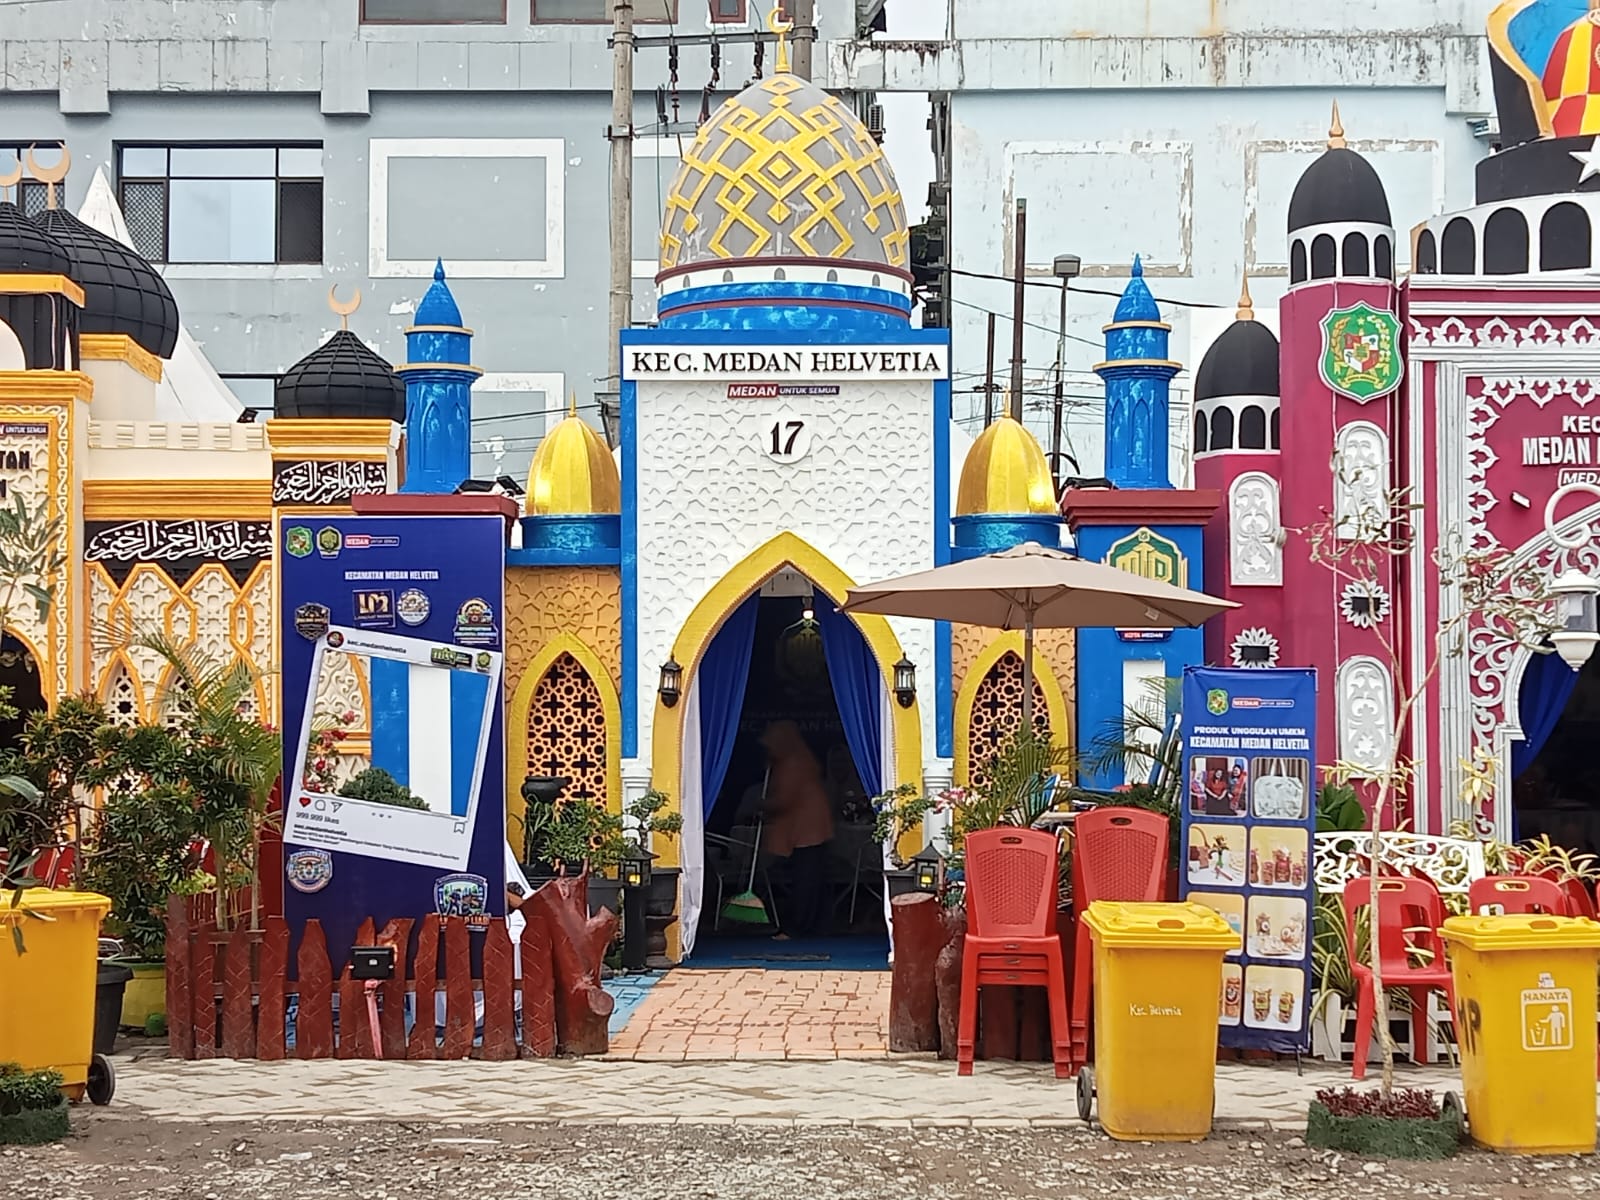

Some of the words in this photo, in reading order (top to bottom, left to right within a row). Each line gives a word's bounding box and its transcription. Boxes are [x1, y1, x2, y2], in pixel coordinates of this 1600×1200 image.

[632, 352, 698, 373] KEC.
[703, 352, 802, 373] MEDAN
[811, 352, 942, 373] HELVETIA
[729, 385, 777, 397] MEDAN
[779, 387, 808, 395] UNTUK
[809, 387, 837, 395] SEMUA
[769, 421, 805, 456] 17
[1522, 436, 1592, 466] MEDAN
[385, 570, 409, 580] MEDAN
[409, 570, 439, 580] HELVETIA
[1193, 726, 1230, 736] PRODUK
[1231, 727, 1278, 736] UNGGULAN
[1278, 728, 1306, 737] UMKM
[1189, 735, 1240, 749] KECAMATAN
[1240, 737, 1271, 750] MEDAN
[1272, 738, 1310, 751] HELVETIA
[1523, 991, 1569, 1002] HANATA
